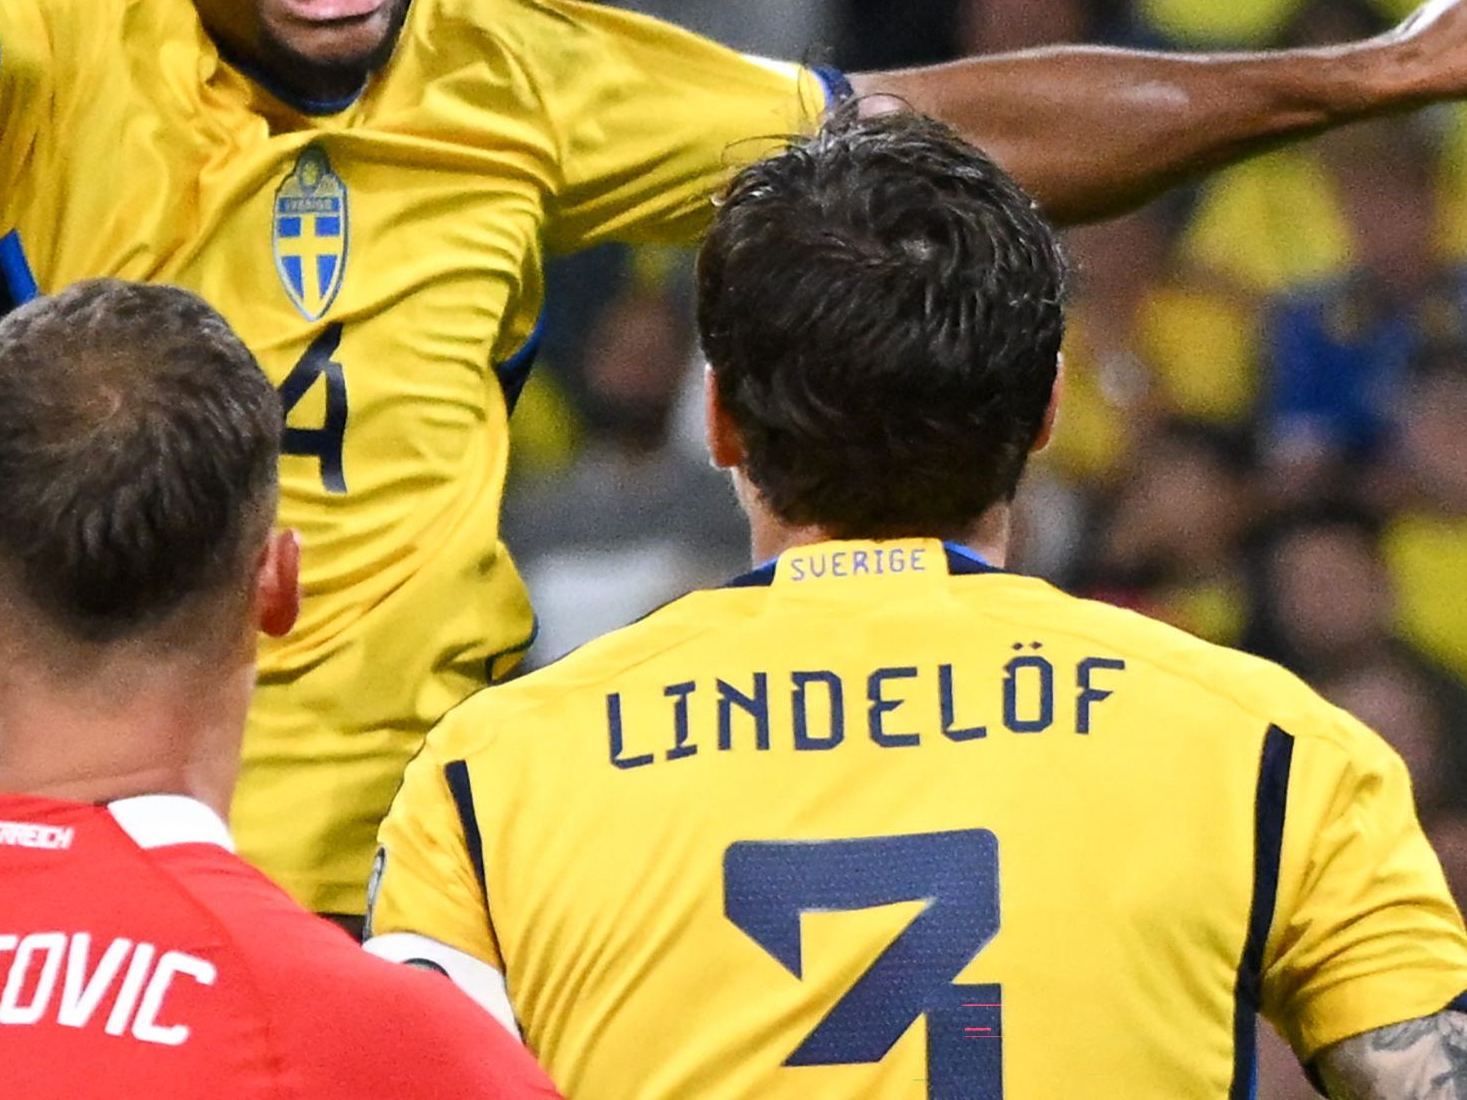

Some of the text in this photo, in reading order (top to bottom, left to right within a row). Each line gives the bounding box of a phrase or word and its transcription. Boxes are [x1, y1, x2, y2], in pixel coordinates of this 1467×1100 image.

[277, 321, 348, 494] 4
[790, 546, 927, 582] SVERIGE
[606, 640, 1126, 770] LINDELÖF
[723, 828, 1004, 1100] 3
